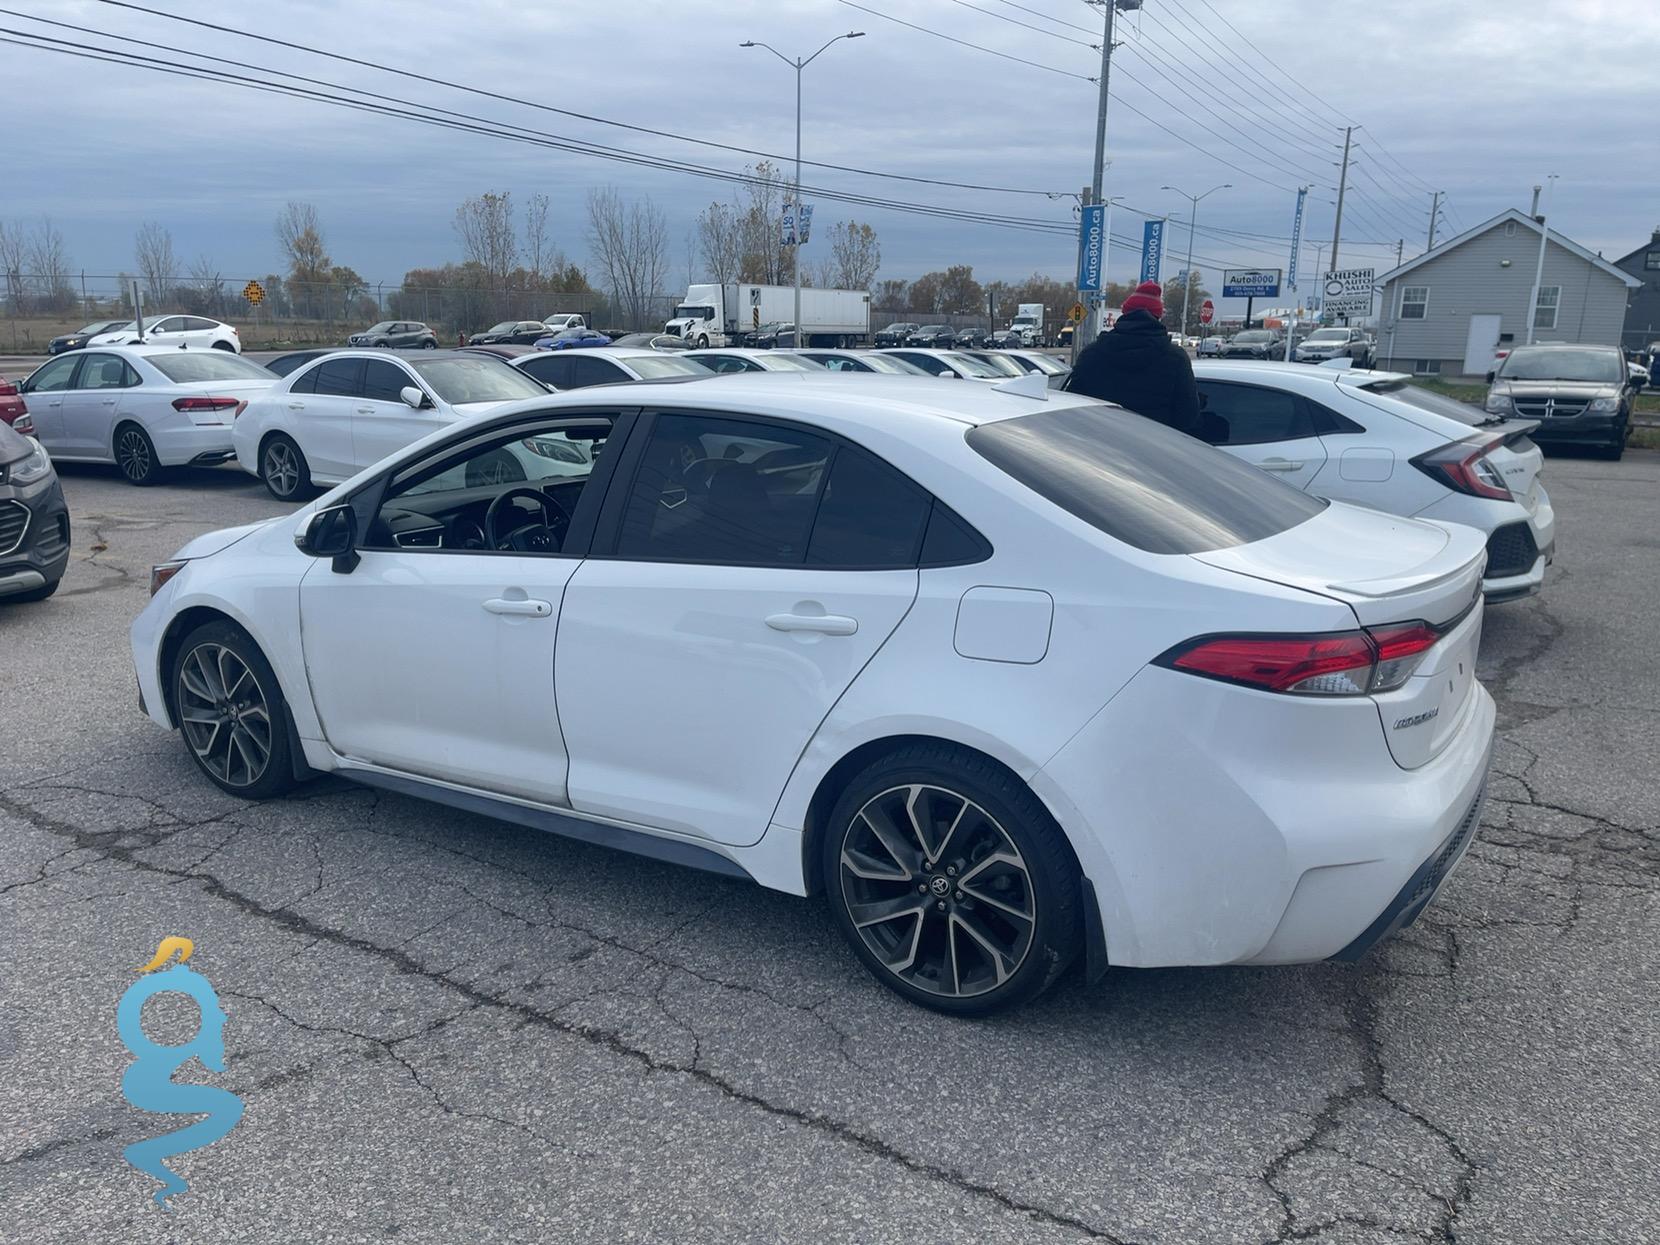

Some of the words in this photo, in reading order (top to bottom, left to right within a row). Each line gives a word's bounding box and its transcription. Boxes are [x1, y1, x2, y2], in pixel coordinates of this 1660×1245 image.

[1086, 209, 1101, 287] Auto8000.ca
[1230, 275, 1274, 284] Auto8000
[1326, 270, 1371, 281] KHUSHI
[1201, 307, 1213, 317] STOP
